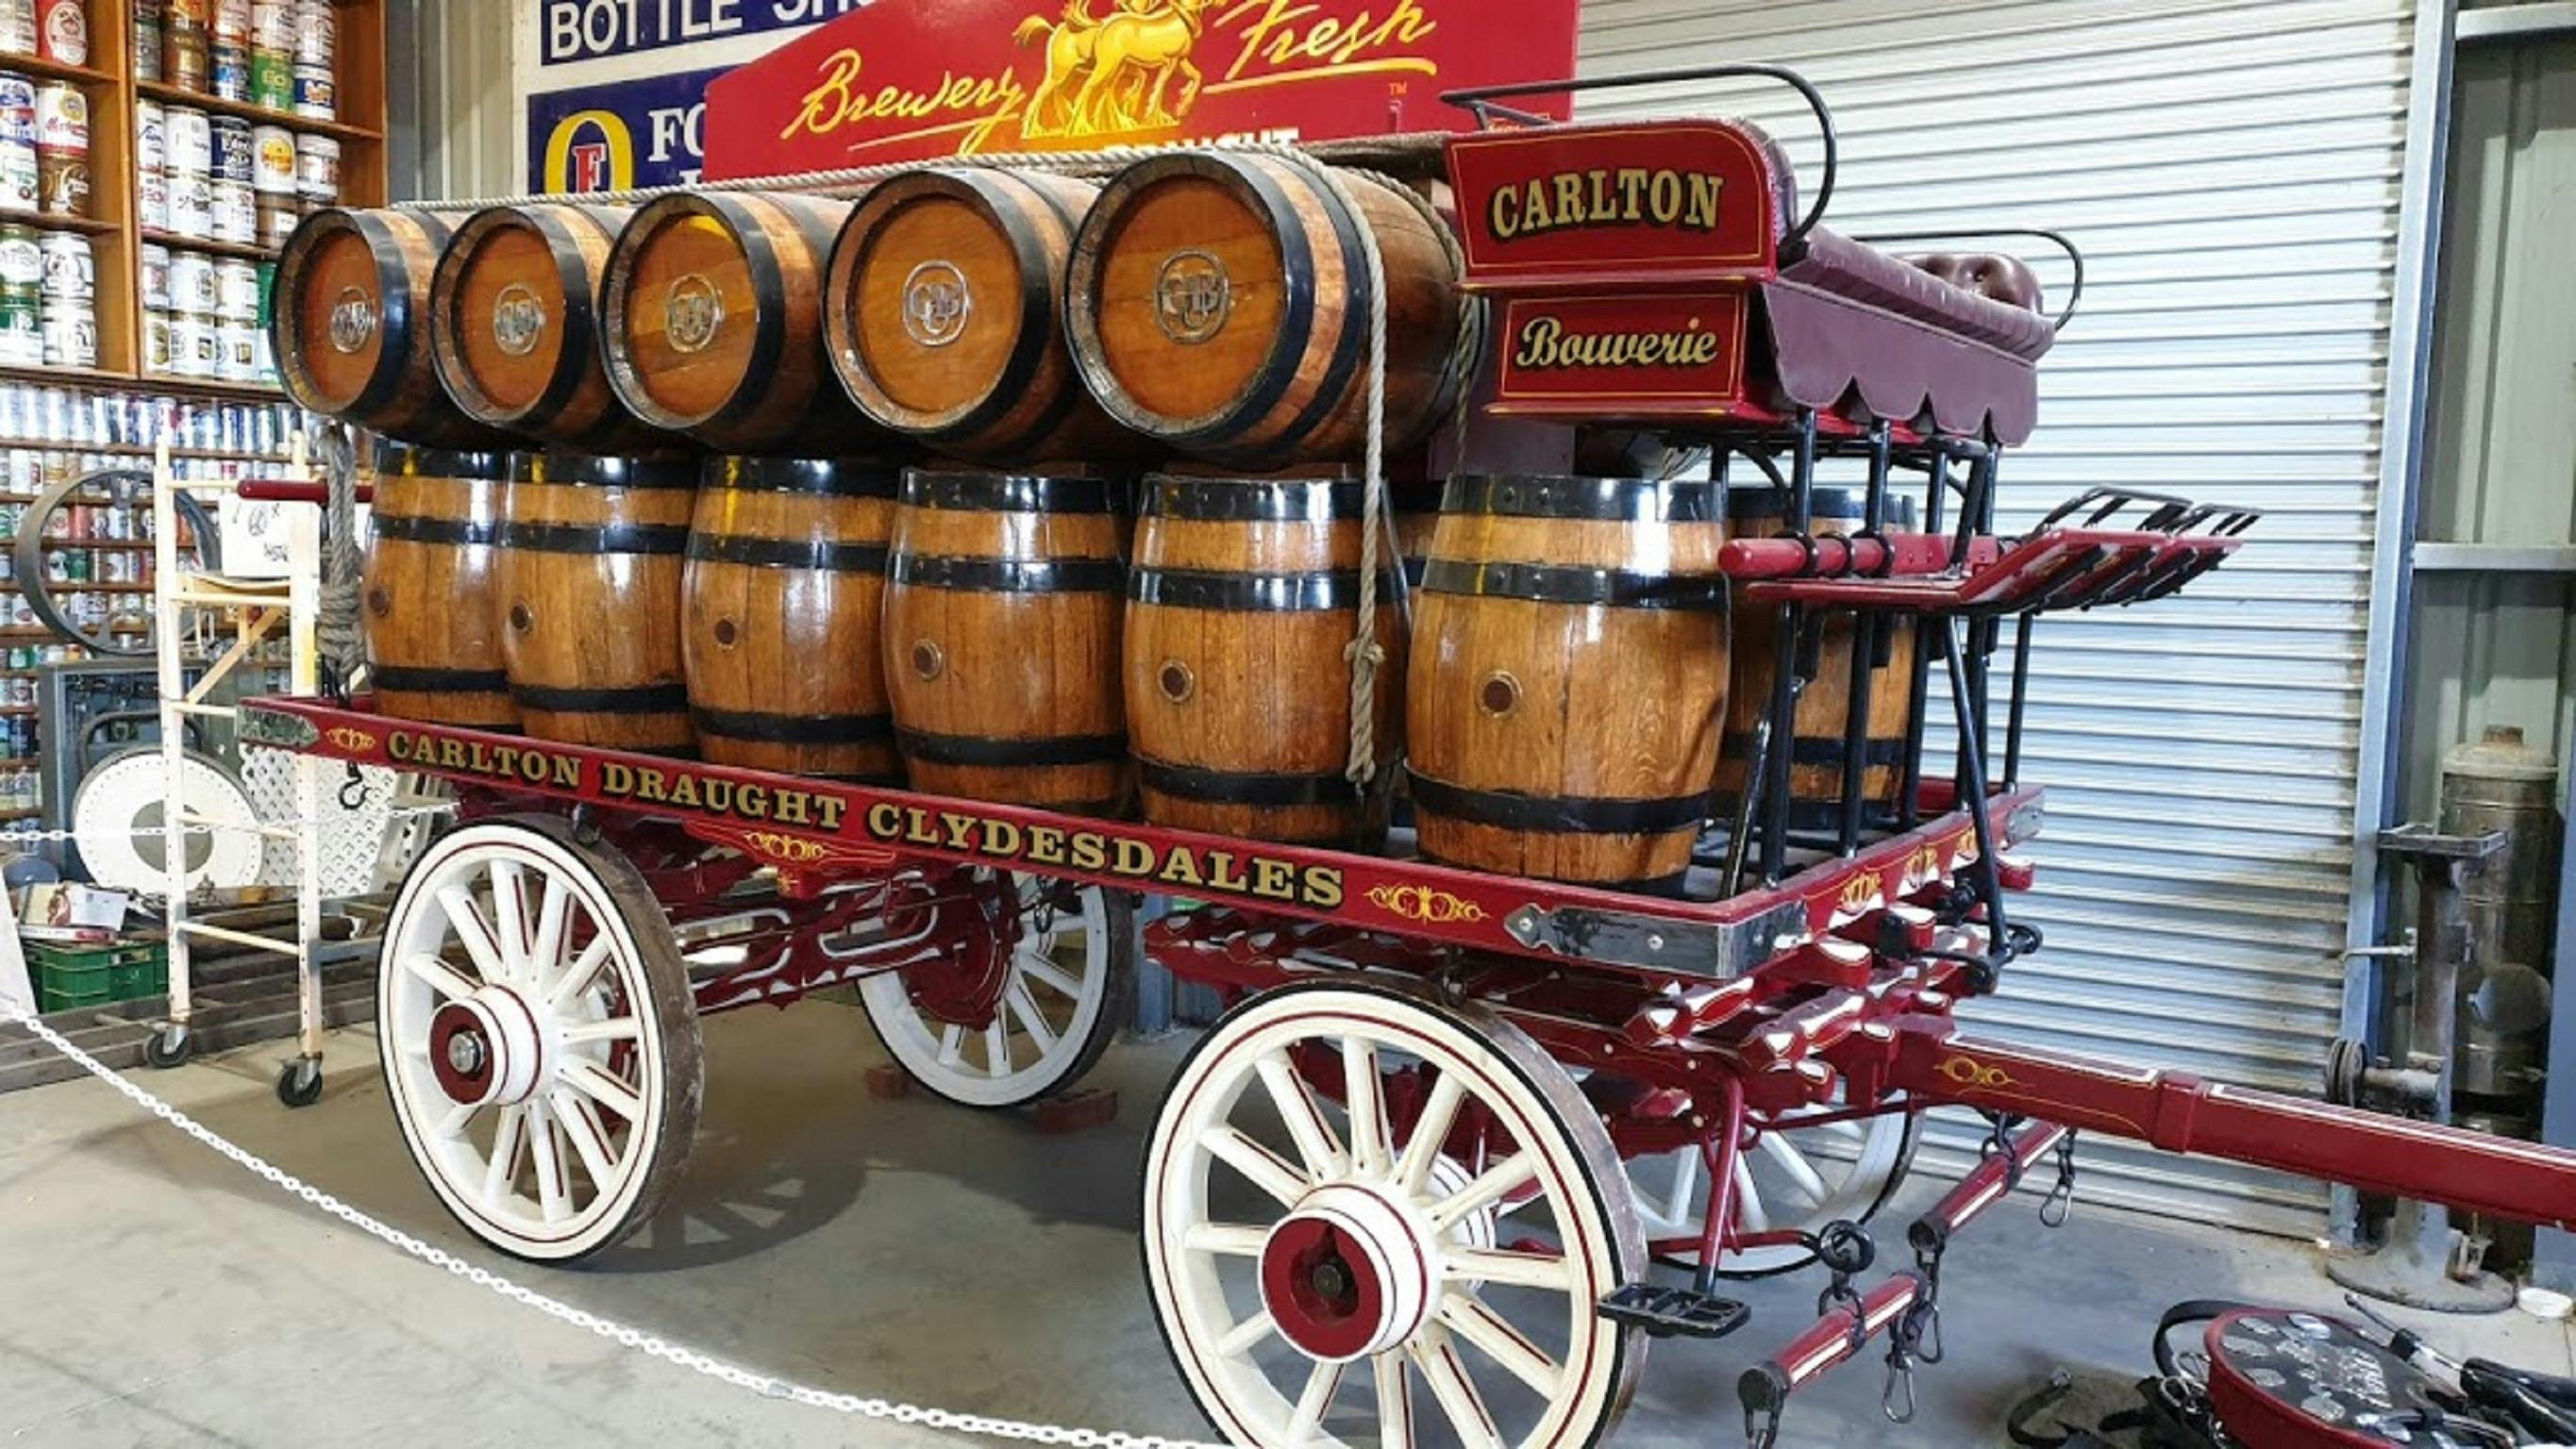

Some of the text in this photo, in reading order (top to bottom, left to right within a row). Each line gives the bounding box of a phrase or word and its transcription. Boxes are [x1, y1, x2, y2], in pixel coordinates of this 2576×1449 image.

[550, 0, 743, 58] BOTTLE
[779, 0, 1437, 156] Brewery Fresh
[1492, 168, 1725, 239] CARLTON
[1515, 316, 1719, 368] Bouverie
[388, 730, 1345, 907] CARLTON DRAUGHT CLYDESDALES
